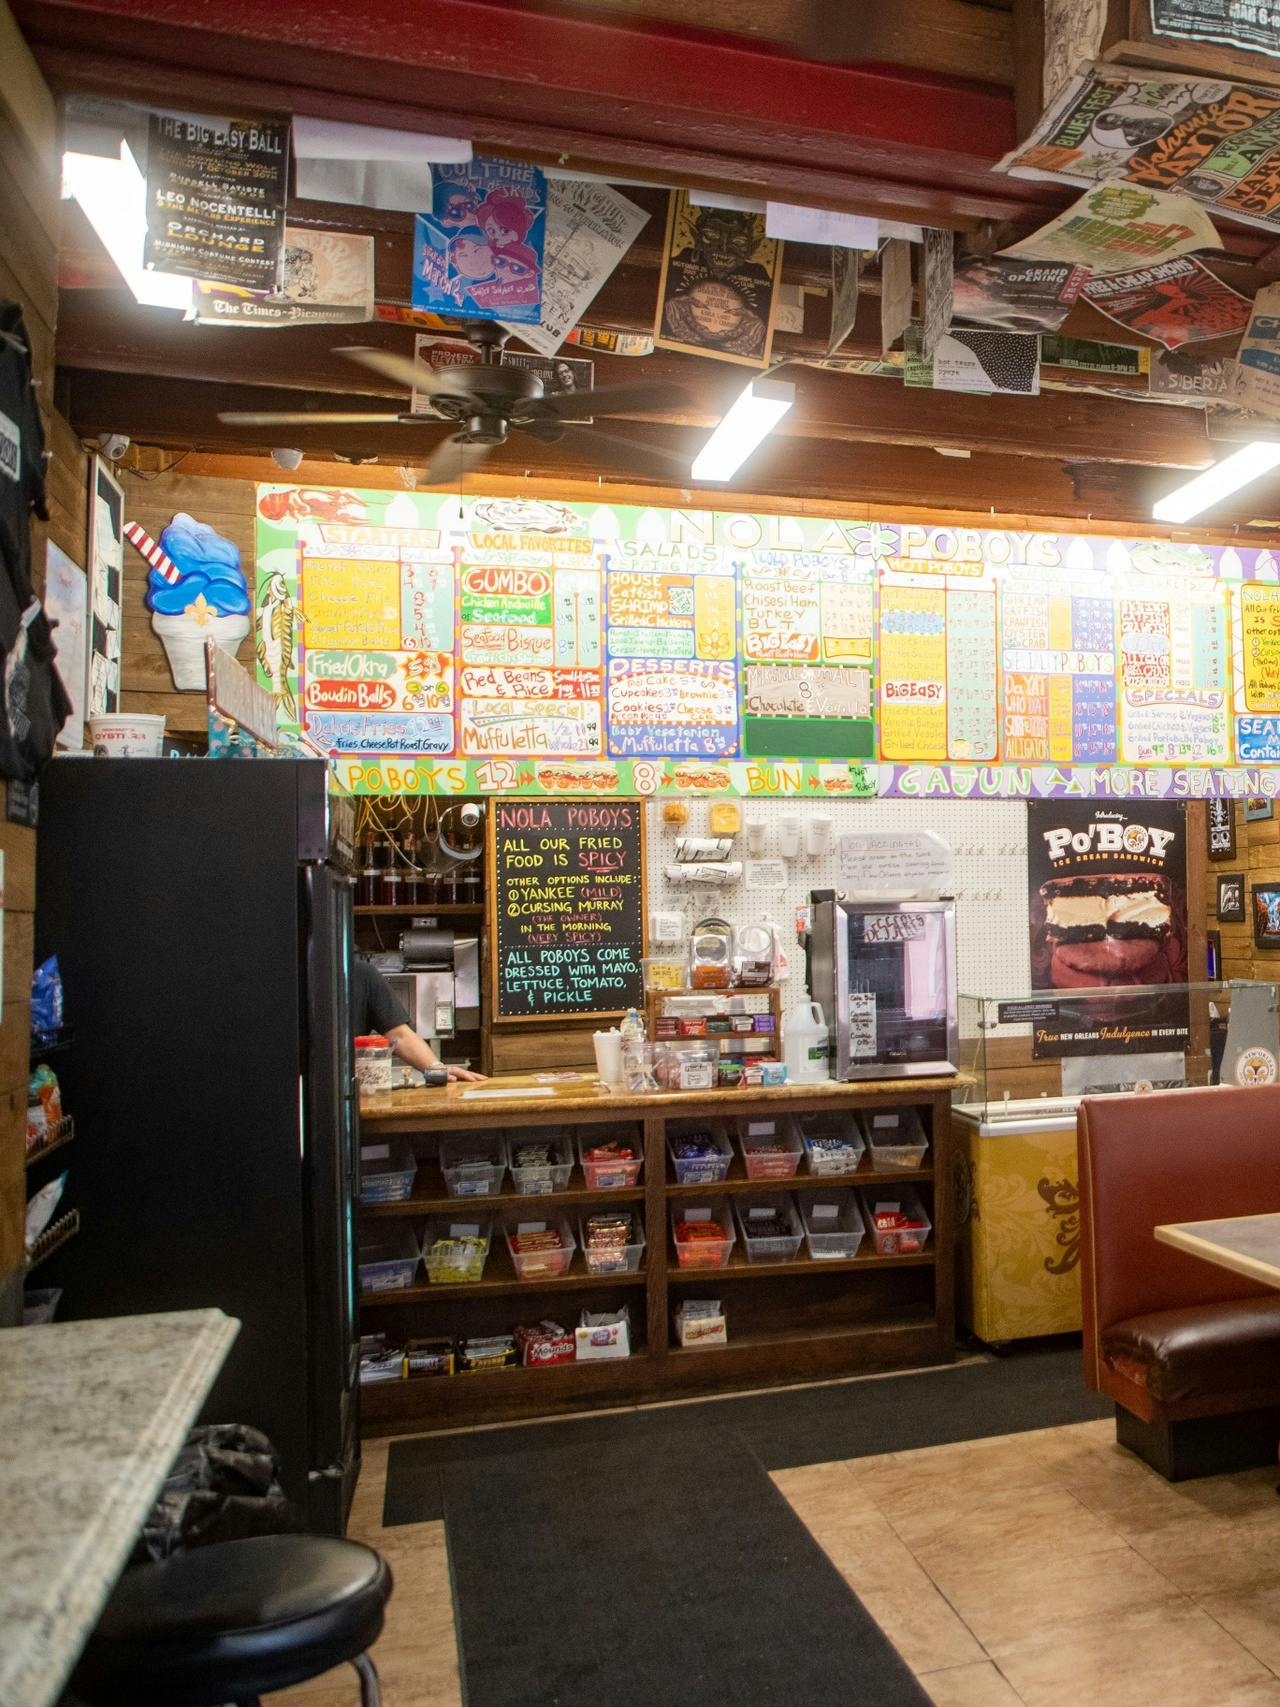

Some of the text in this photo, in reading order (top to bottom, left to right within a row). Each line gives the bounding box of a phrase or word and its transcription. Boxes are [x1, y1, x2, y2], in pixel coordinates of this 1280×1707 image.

[155, 116, 282, 155] THE BIG EASY BALL
[1055, 110, 1095, 148] BLUES
[156, 188, 277, 220] LEO NOCENTELLI
[167, 221, 265, 245] ORCHARD
[167, 229, 265, 253] LOUNGE
[1007, 273, 1065, 284] OPENING
[1024, 267, 1069, 278] GRAND
[1119, 258, 1194, 290] CHEAP SHOWS
[212, 299, 242, 314] The
[1168, 374, 1228, 391] SIBERIA
[471, 534, 593, 554] LOCAL FAVORITES
[670, 510, 1062, 568] NOLA POBOYS
[623, 539, 719, 561] SALADS
[927, 560, 983, 577] POBOYS
[464, 569, 546, 597] GUMBO
[609, 573, 662, 586] HOUSE
[744, 580, 815, 594] Roast Beef
[609, 585, 662, 600] Catfish
[609, 599, 669, 613] SHRIMP
[793, 596, 818, 608] Ham
[471, 608, 537, 625] Seafood
[748, 606, 806, 620] Turkey
[506, 626, 552, 656] Bisque
[310, 653, 389, 680] Fried Okra
[609, 658, 736, 679] DESSERTS
[463, 669, 547, 692] Red Beans
[511, 681, 550, 697] Rice
[310, 681, 394, 709] Boudin Balls
[1130, 689, 1220, 706] SPECIALS
[472, 700, 586, 720] Local Special
[749, 696, 805, 714] Chocolate
[422, 738, 449, 752] Gravy
[463, 725, 548, 751] Muffuletta
[621, 735, 699, 753] Muffuletta
[348, 764, 467, 792] POBOYS
[745, 766, 802, 792] BUN
[898, 766, 1032, 796] CAJUN
[1090, 768, 1277, 797] MORE SEATING
[501, 807, 633, 829] NOLA POBOYS
[503, 837, 623, 853] ALL OUR FRIED
[506, 851, 627, 869] FOOD IS SPICY
[1053, 853, 1165, 868] ICE CREAM SANDWICH
[506, 876, 539, 887] OTHER
[546, 874, 590, 885] OPTIONS
[520, 886, 623, 900] YANKEE (MILD)
[520, 899, 625, 915] CURSING MURRAY
[560, 912, 603, 923] OWNER)
[520, 922, 612, 934] IN THE MORNING
[507, 948, 631, 965] ALL POBOYS COME
[504, 962, 640, 979] DRESSED WITH MAYO,
[571, 976, 628, 990] TOMATO,
[543, 990, 594, 1003] PICKLE
[1036, 1029, 1060, 1044] True
[1074, 1031, 1100, 1041] ORLEANS
[1100, 1026, 1151, 1043] Indulgence
[1158, 1028, 1176, 1037] EVERY
[1176, 1027, 1189, 1036] BITE
[532, 1341, 575, 1358] Mounds
